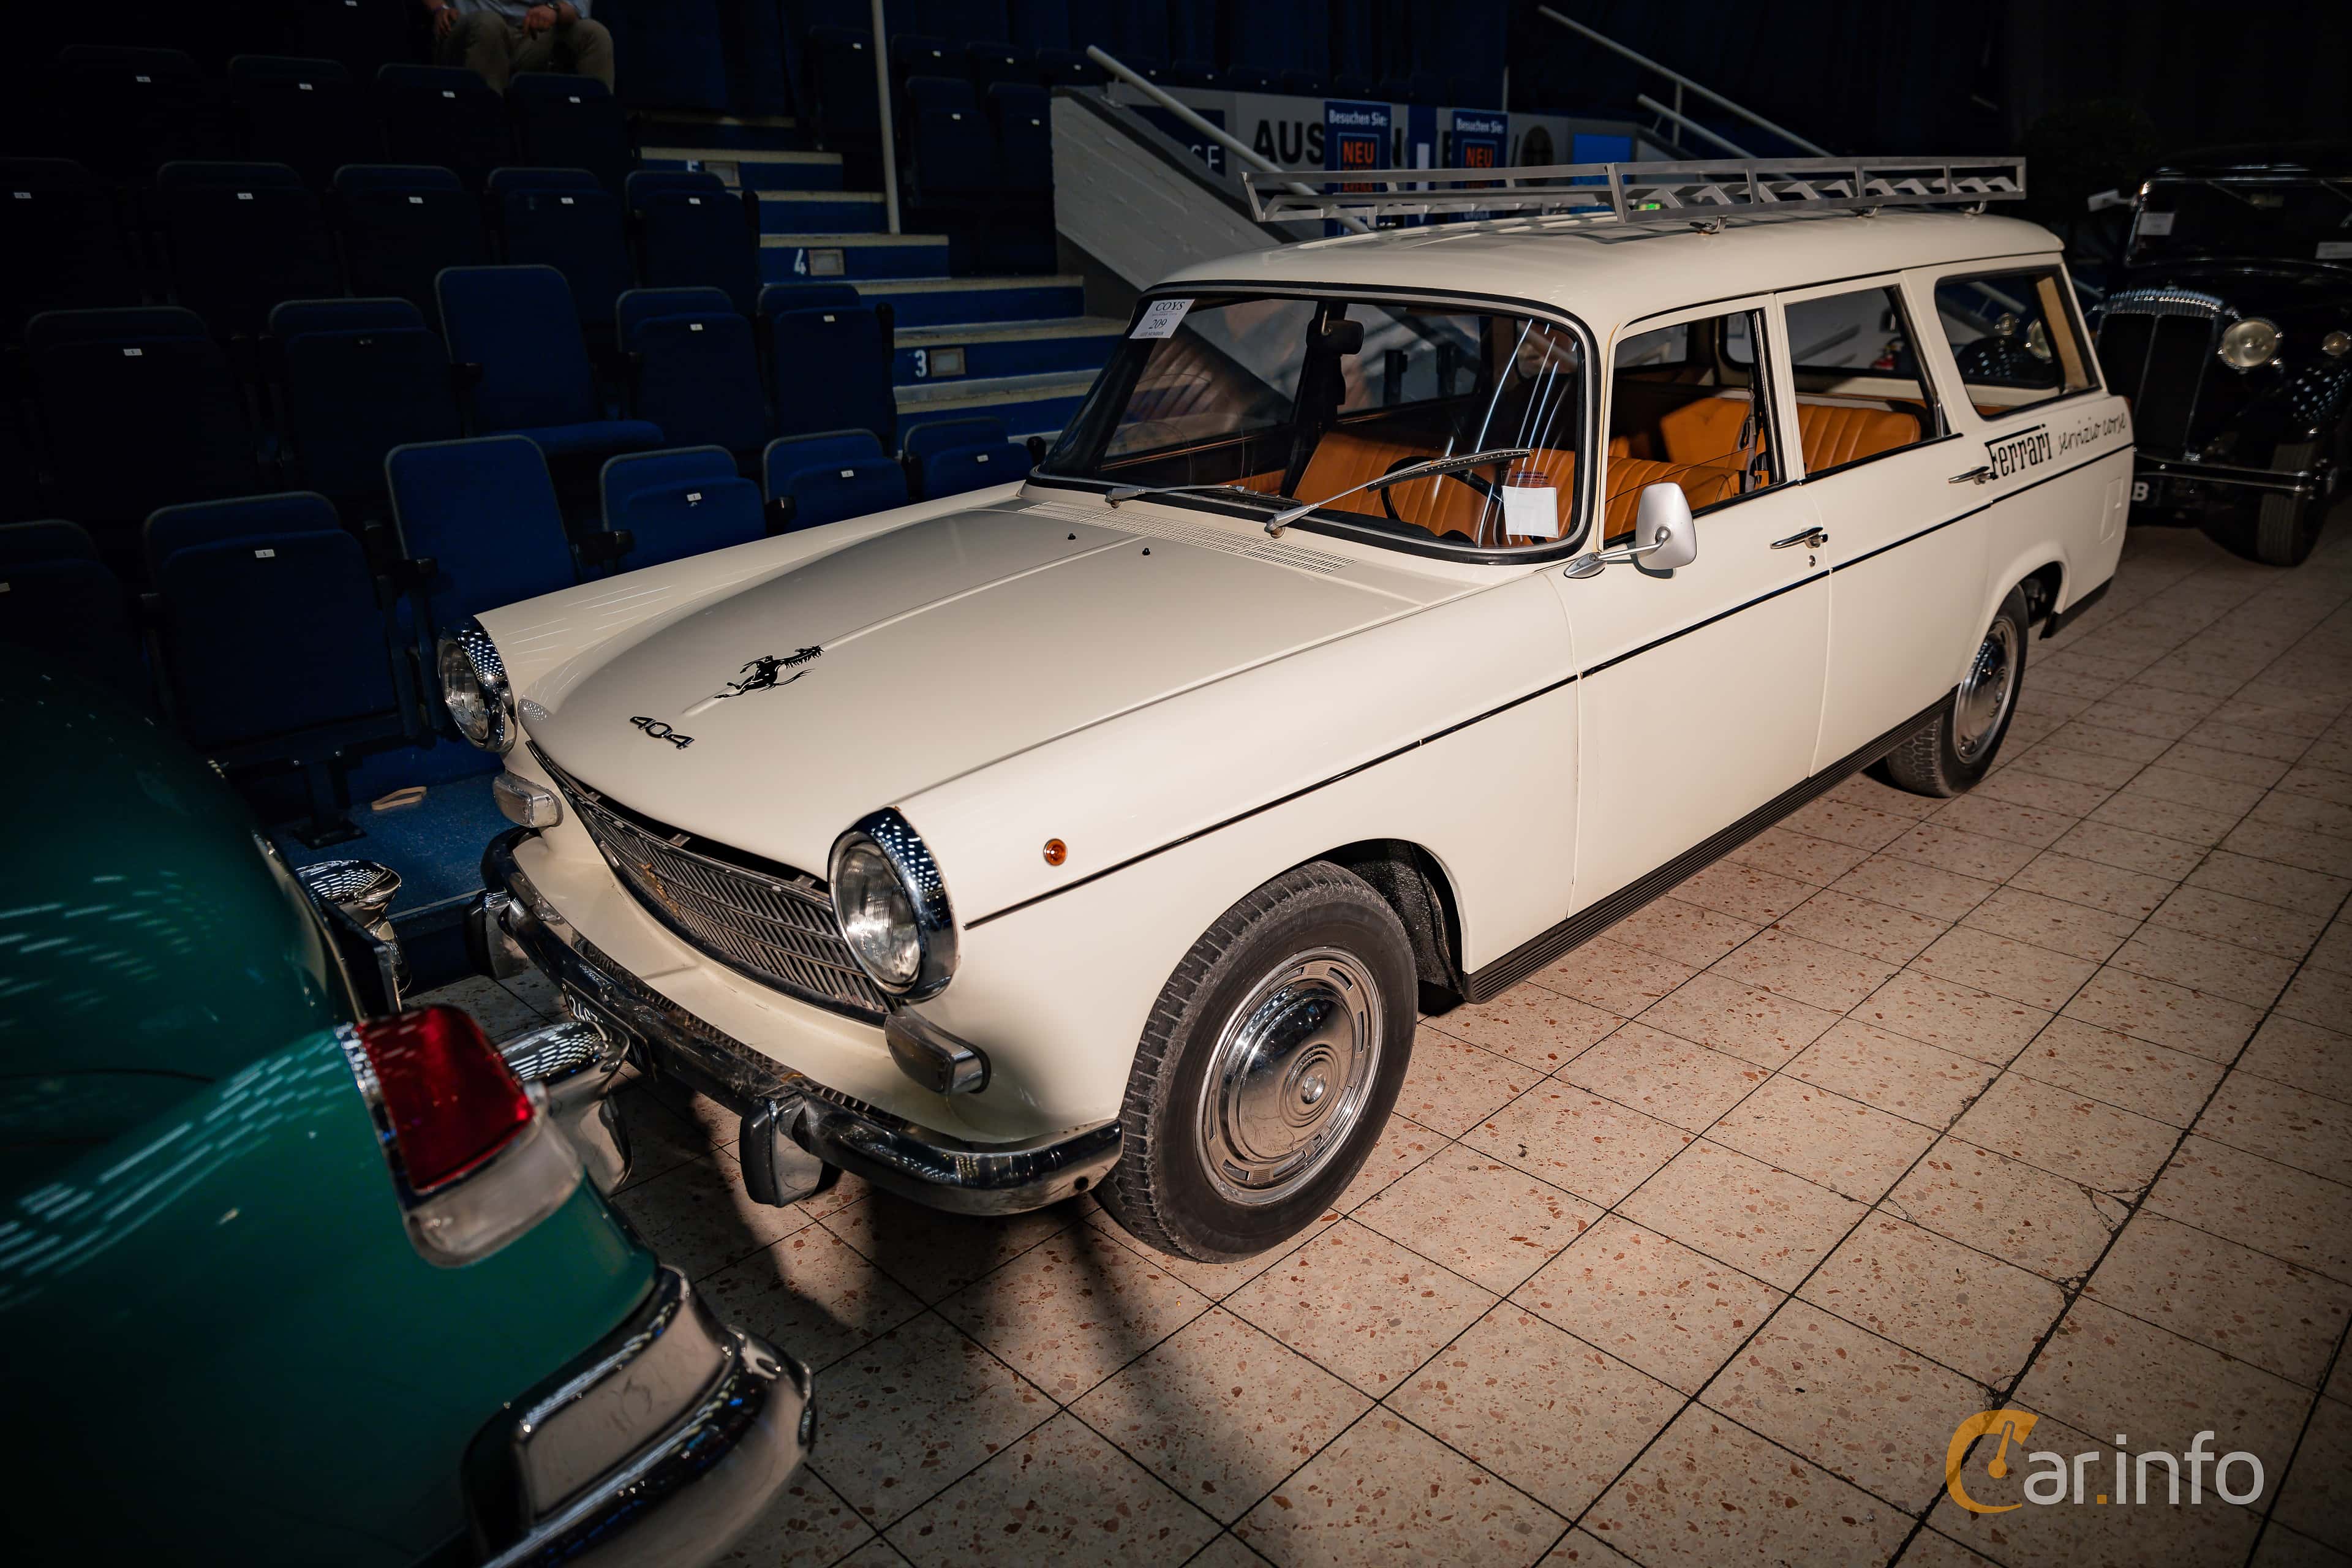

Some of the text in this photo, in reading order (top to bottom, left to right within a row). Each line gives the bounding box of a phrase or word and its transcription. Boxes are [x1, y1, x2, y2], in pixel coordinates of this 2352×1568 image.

[1343, 140, 1375, 165] NEU
[1465, 146, 1494, 167] NEU
[1156, 301, 1185, 311] COYS
[914, 350, 927, 377] 3
[1985, 424, 2052, 480] Ferrari
[630, 716, 695, 750] 404
